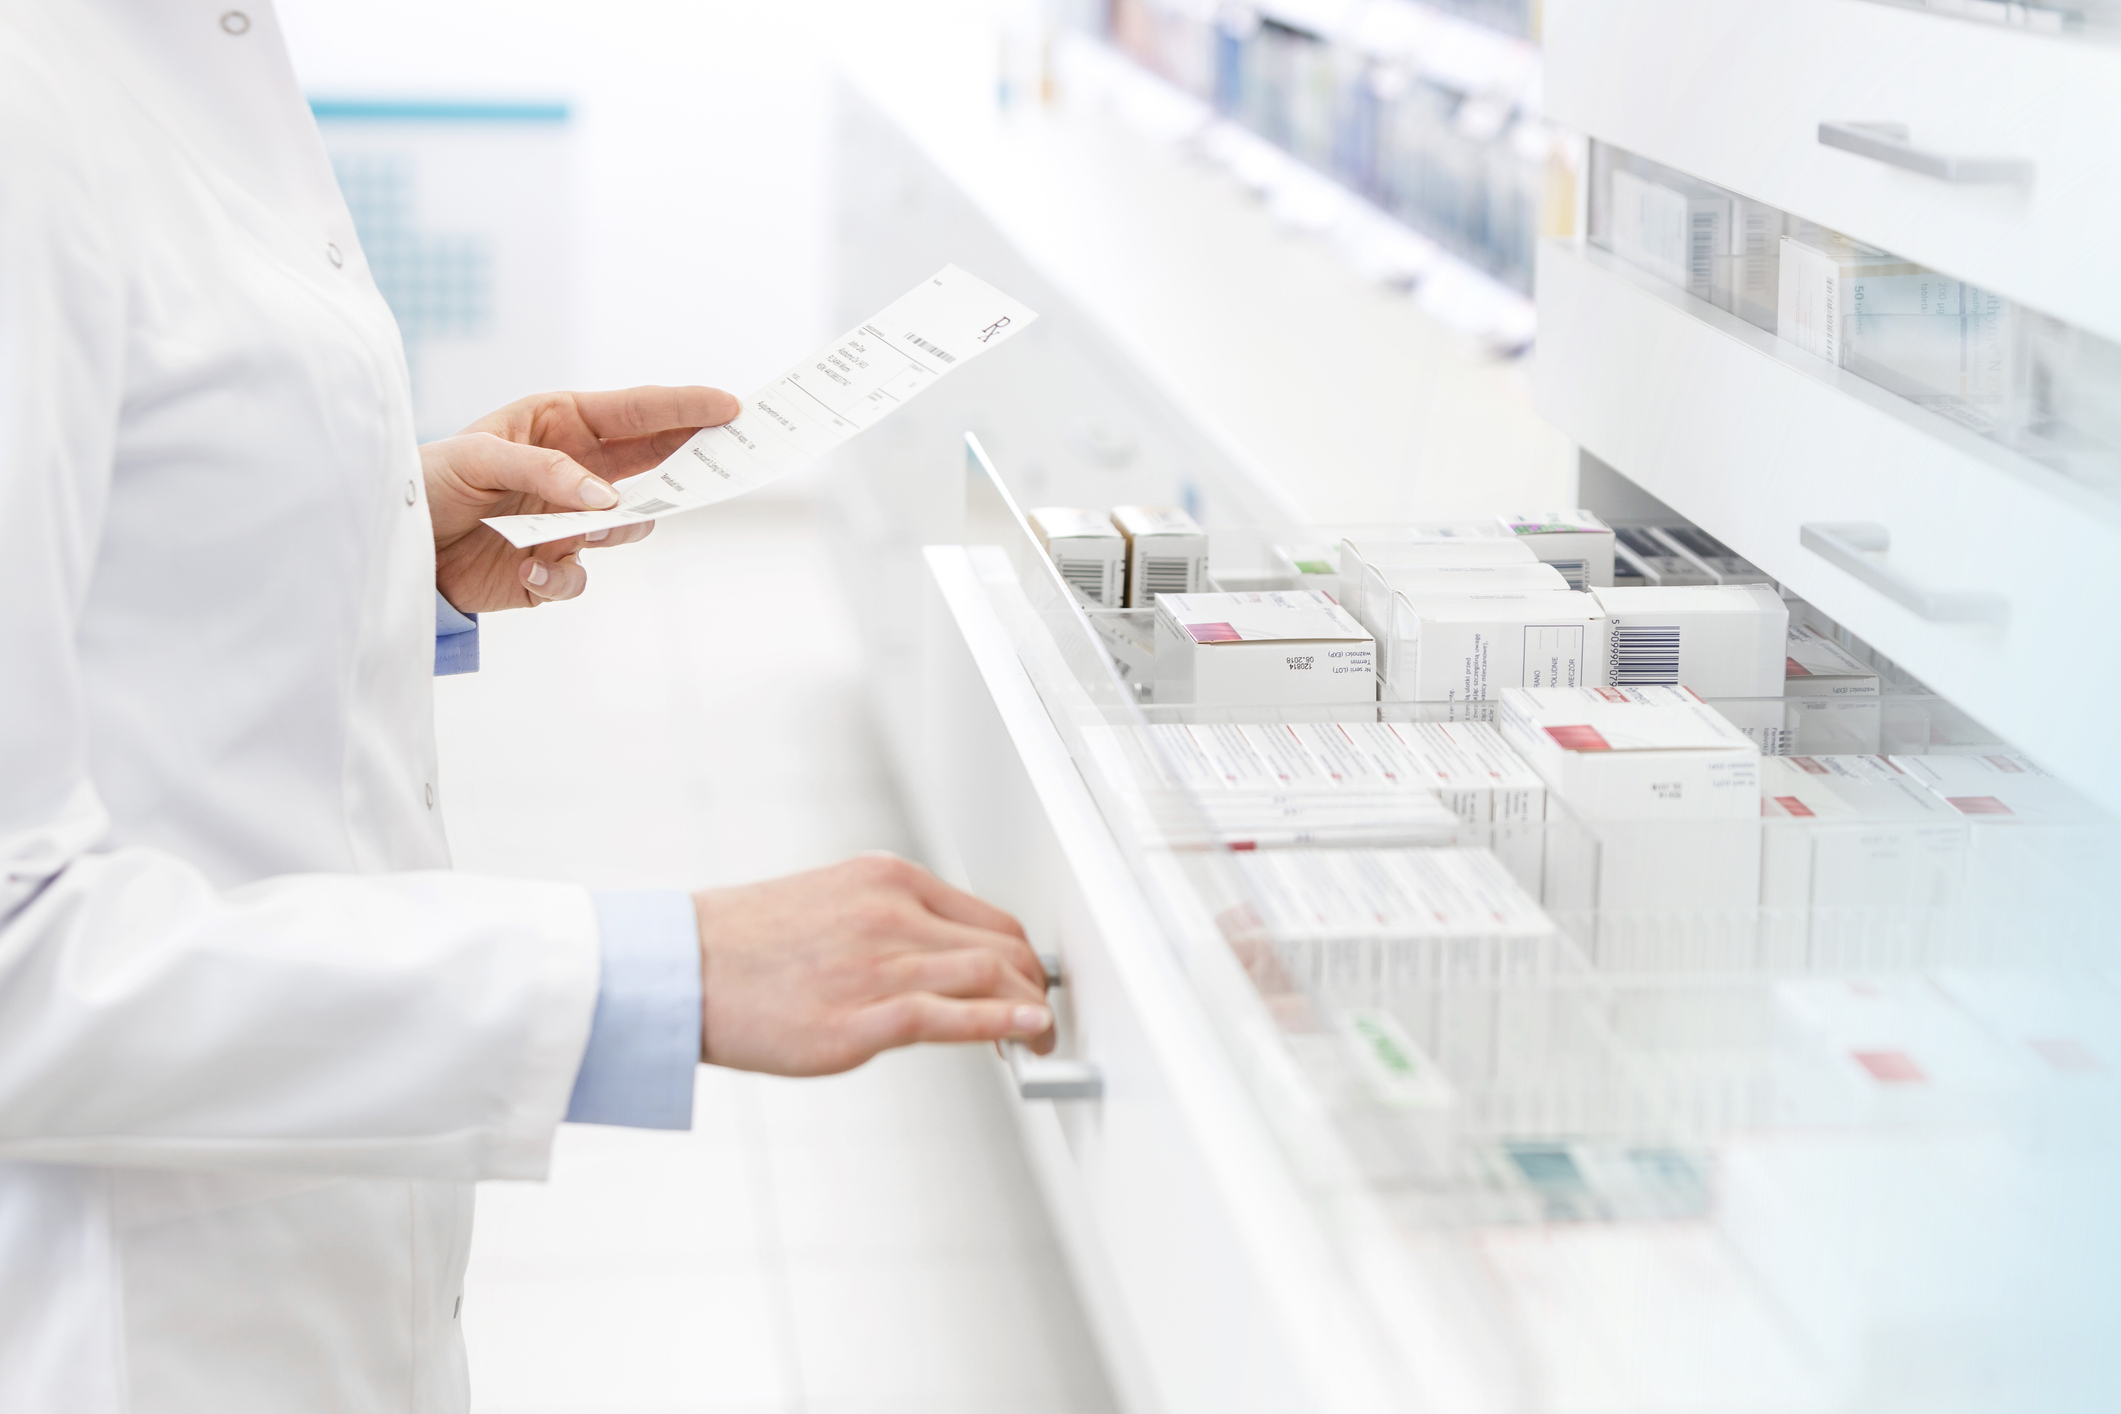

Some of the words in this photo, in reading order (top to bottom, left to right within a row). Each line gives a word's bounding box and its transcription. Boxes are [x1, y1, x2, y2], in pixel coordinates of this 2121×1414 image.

[1854, 286, 1864, 300] 50
[1920, 283, 1928, 314] tabletki
[1938, 282, 1946, 300] 200
[1610, 630, 1620, 666] 909990
[1550, 656, 1558, 688] POŁUDNIE
